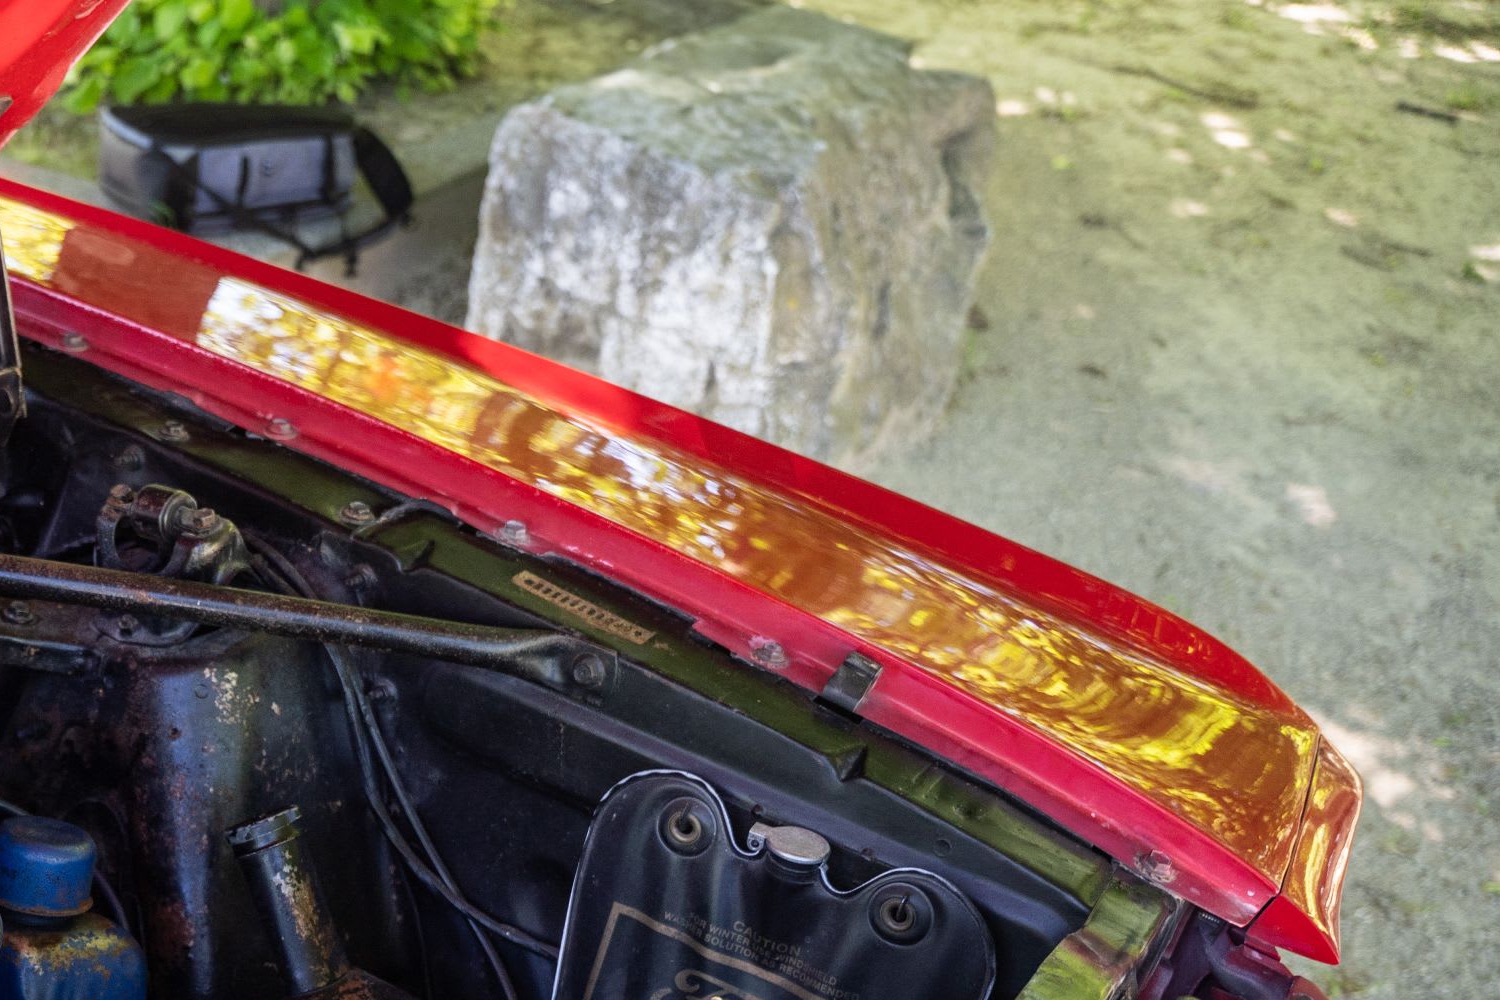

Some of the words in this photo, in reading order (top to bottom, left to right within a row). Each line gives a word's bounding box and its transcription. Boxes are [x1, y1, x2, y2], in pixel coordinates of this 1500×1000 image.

[709, 924, 750, 946] WINTER
[733, 920, 802, 957] CAUTION
[704, 934, 758, 961] SOLUTION
[780, 963, 860, 1000] RECOMMENDED
